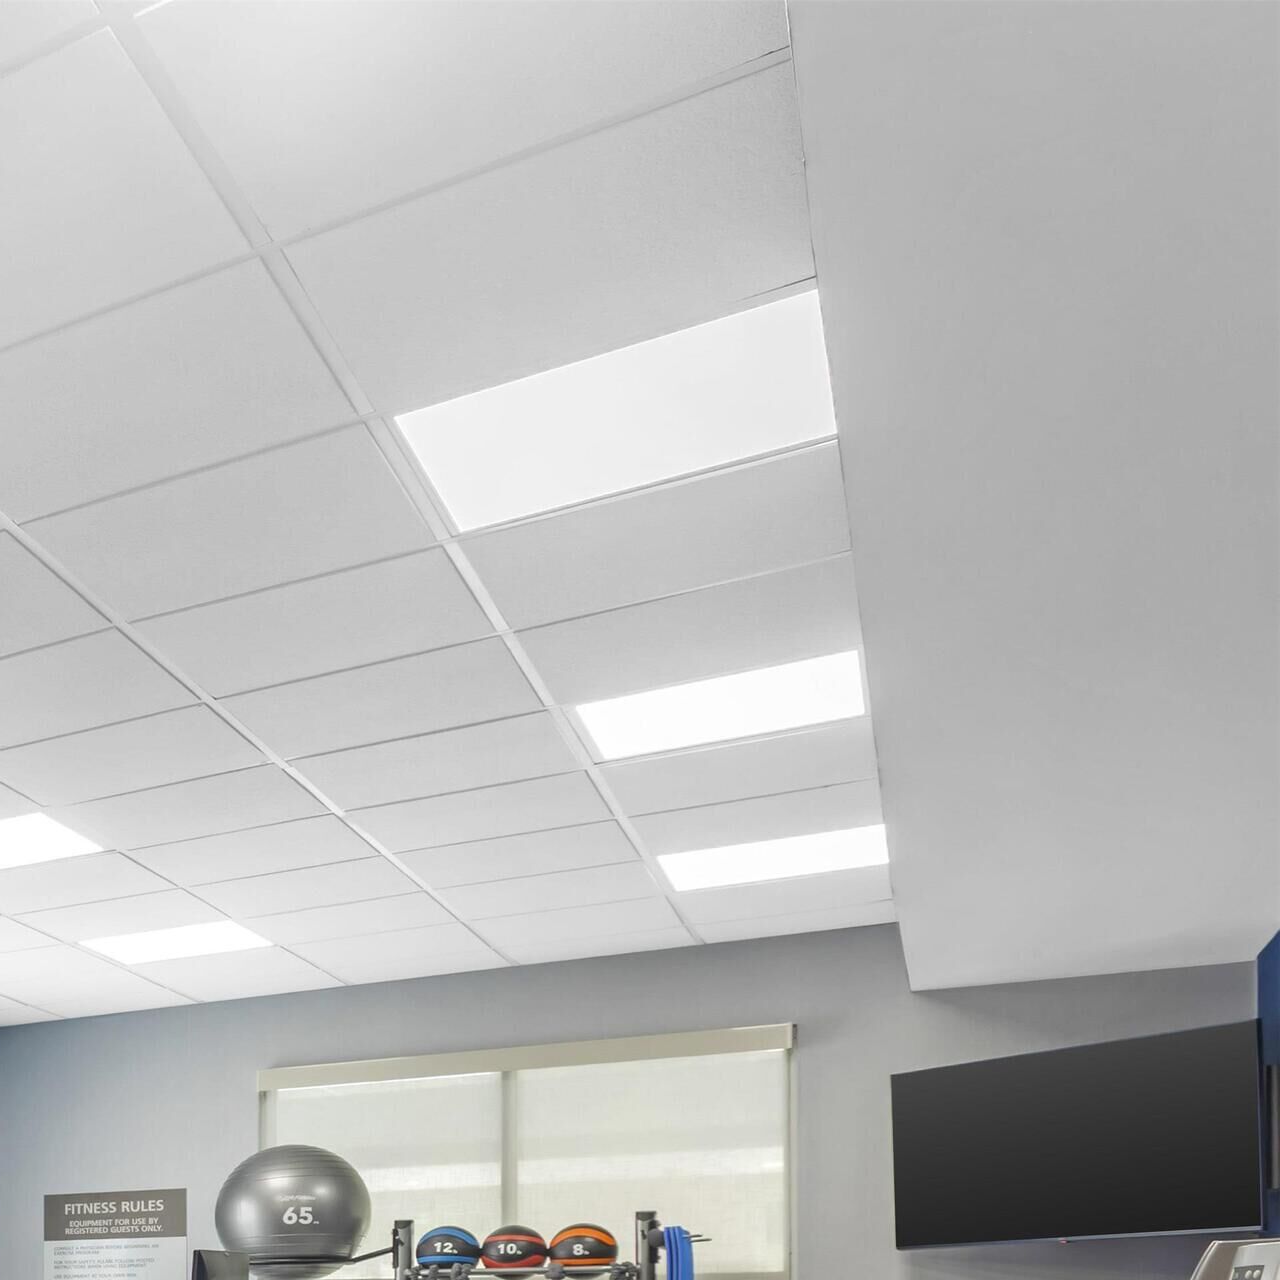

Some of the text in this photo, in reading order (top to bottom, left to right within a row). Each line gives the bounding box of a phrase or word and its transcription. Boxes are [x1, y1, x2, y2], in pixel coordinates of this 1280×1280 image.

[64, 1199, 165, 1215] FITNESS RULES
[282, 1206, 313, 1225] 65
[69, 1217, 159, 1228] EQUIPMENT FOR USE BY
[65, 1227, 109, 1235] REGISTERED
[110, 1226, 140, 1234] GUESTS
